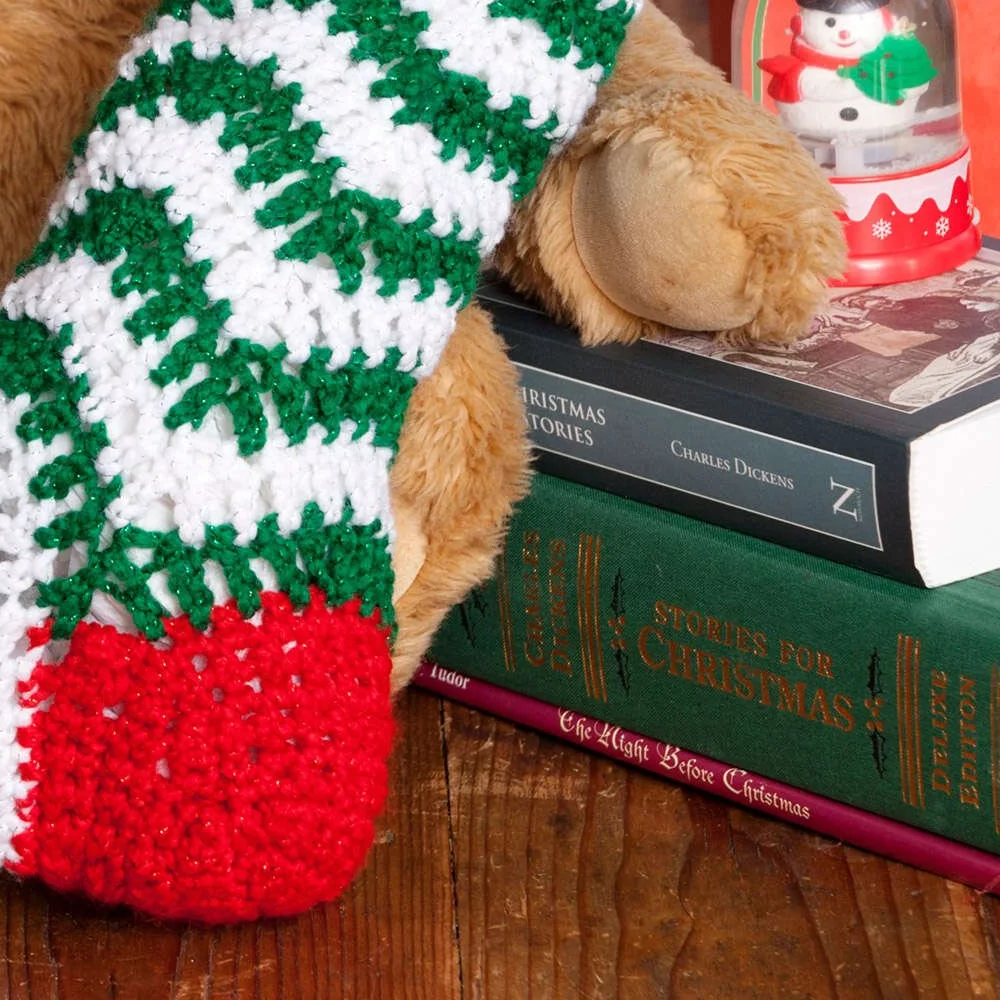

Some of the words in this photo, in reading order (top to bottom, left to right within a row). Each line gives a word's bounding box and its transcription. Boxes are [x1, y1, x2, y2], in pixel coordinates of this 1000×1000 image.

[520, 386, 606, 426] RISTMAS
[637, 624, 856, 733] CHRISTMAS
[654, 599, 768, 658] STORIES
[779, 638, 835, 680] FOR
[557, 706, 592, 743] The
[593, 719, 651, 764] Night
[656, 741, 715, 786] Before
[722, 767, 811, 820] Christmas
[931, 667, 952, 796] DELUXE
[959, 674, 980, 811] EDITION
